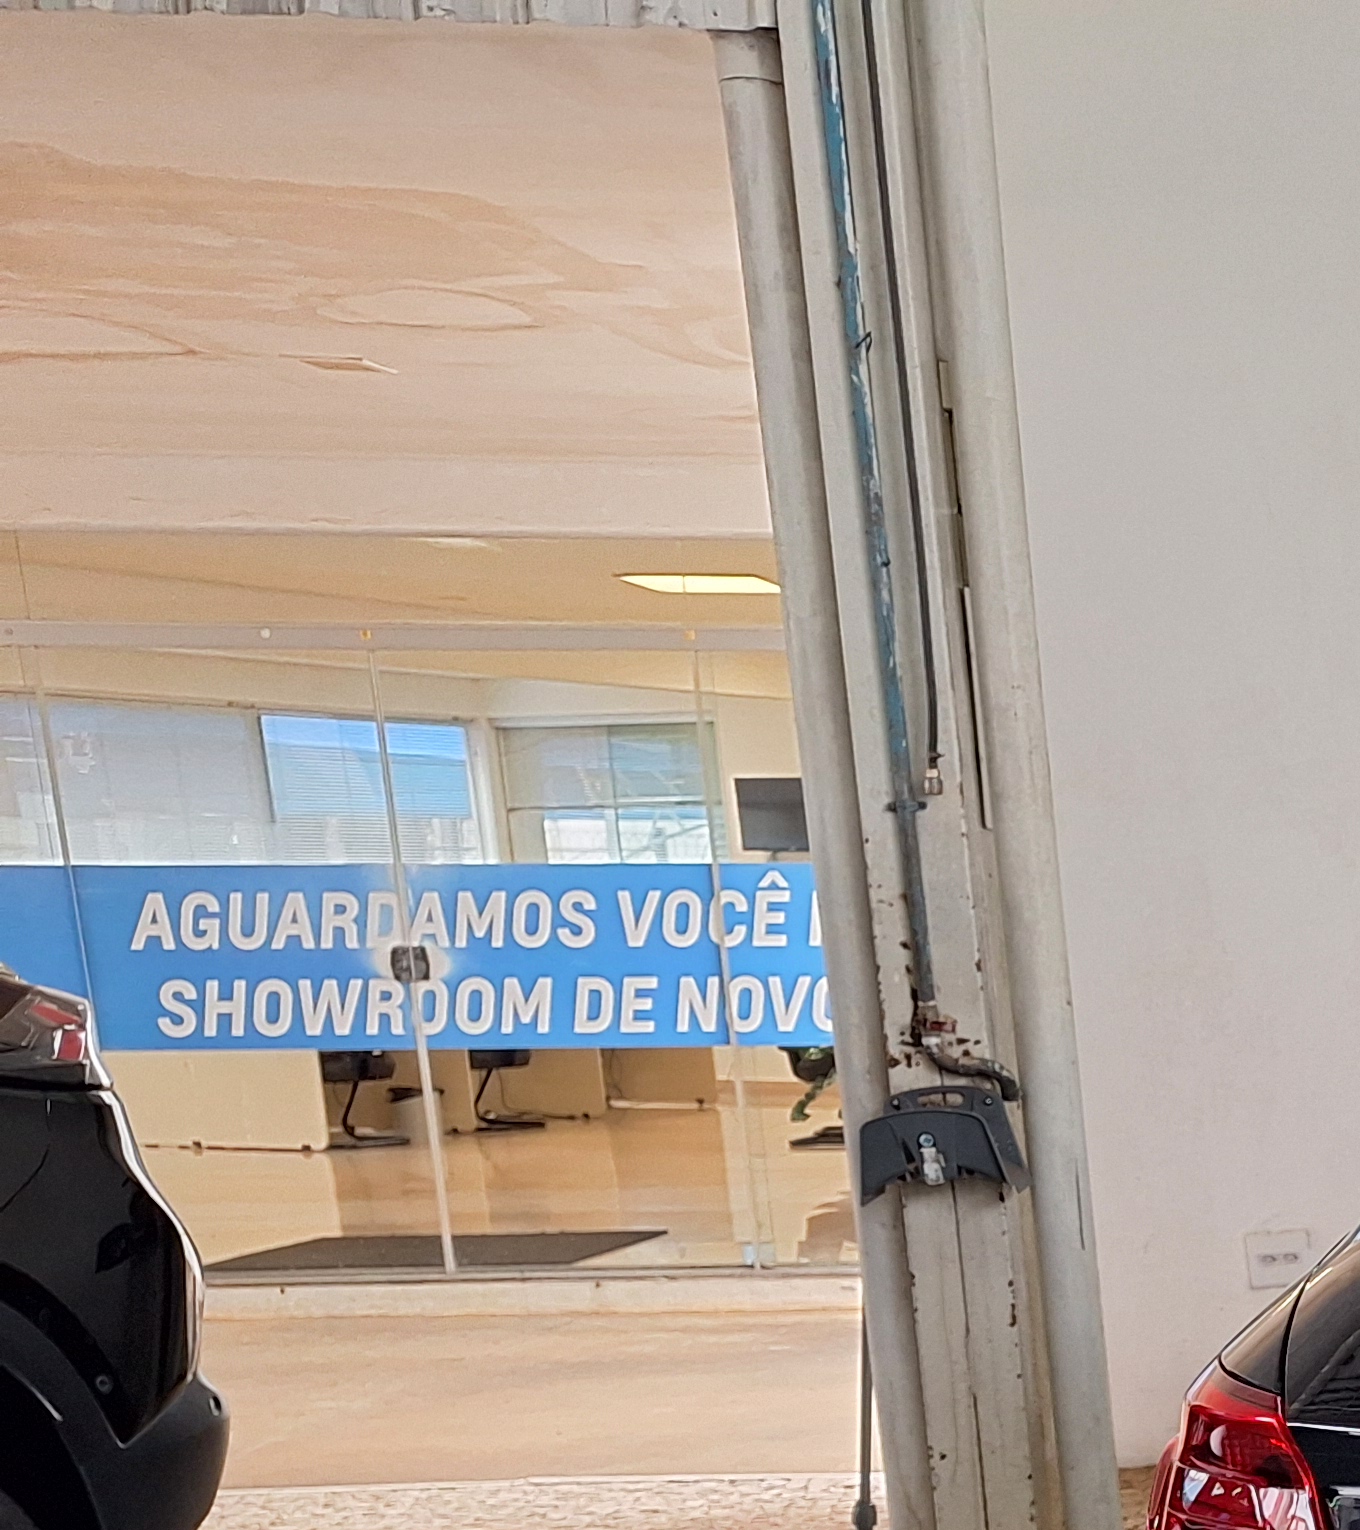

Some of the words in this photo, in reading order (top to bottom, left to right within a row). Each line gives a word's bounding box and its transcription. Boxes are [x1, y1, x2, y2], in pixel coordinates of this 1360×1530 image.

[131, 888, 597, 952] AGUARDAMOS
[617, 869, 791, 950] VOCÊ
[157, 976, 552, 1038] SHOWROOM
[573, 976, 659, 1034] DE
